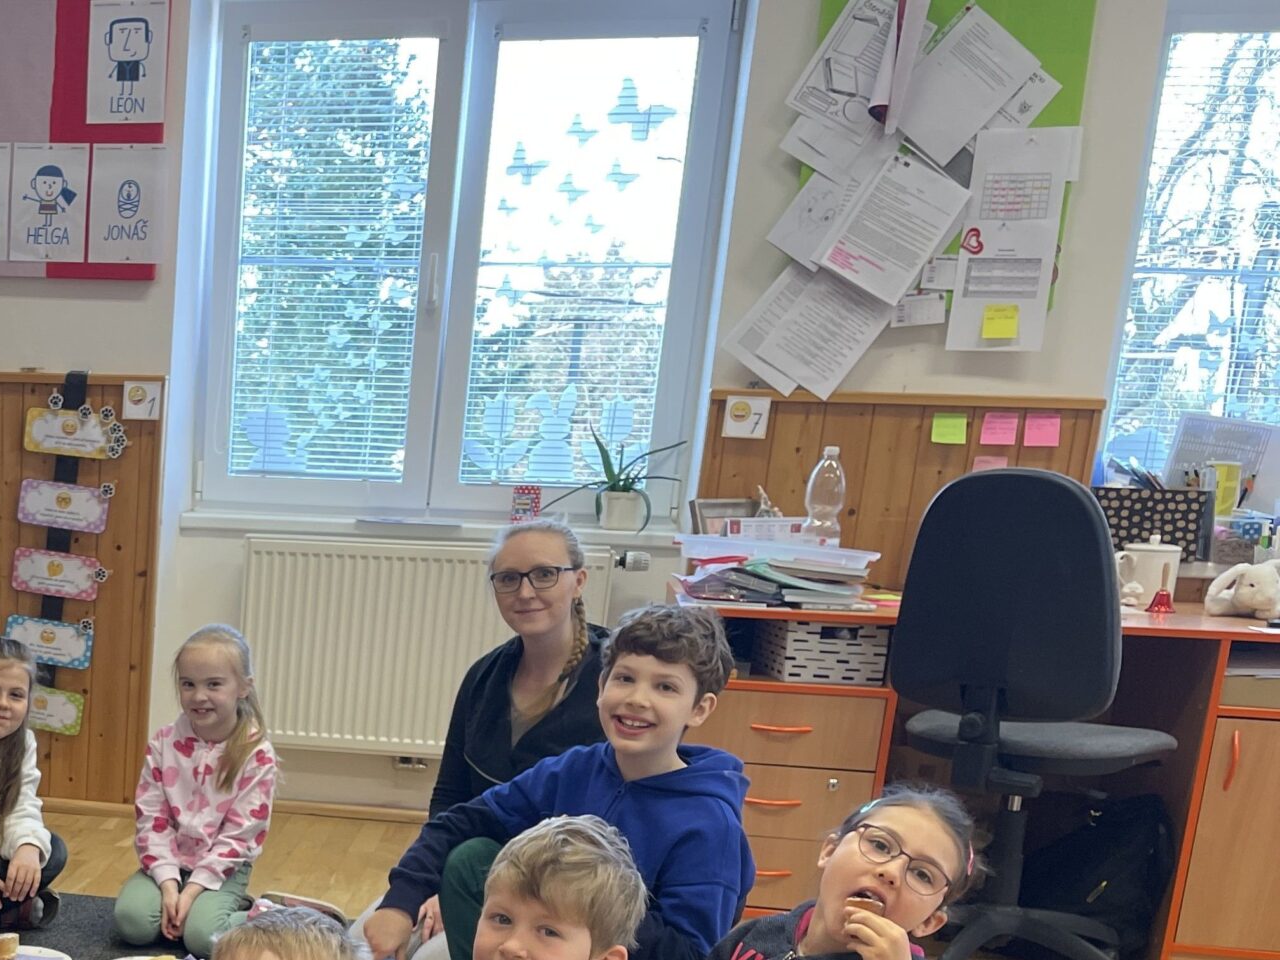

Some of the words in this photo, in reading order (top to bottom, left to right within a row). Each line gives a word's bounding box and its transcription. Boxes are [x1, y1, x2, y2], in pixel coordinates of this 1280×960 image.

[26, 226, 70, 246] HELGA
[103, 218, 149, 241] JONÁŠ
[751, 412, 763, 436] 7
